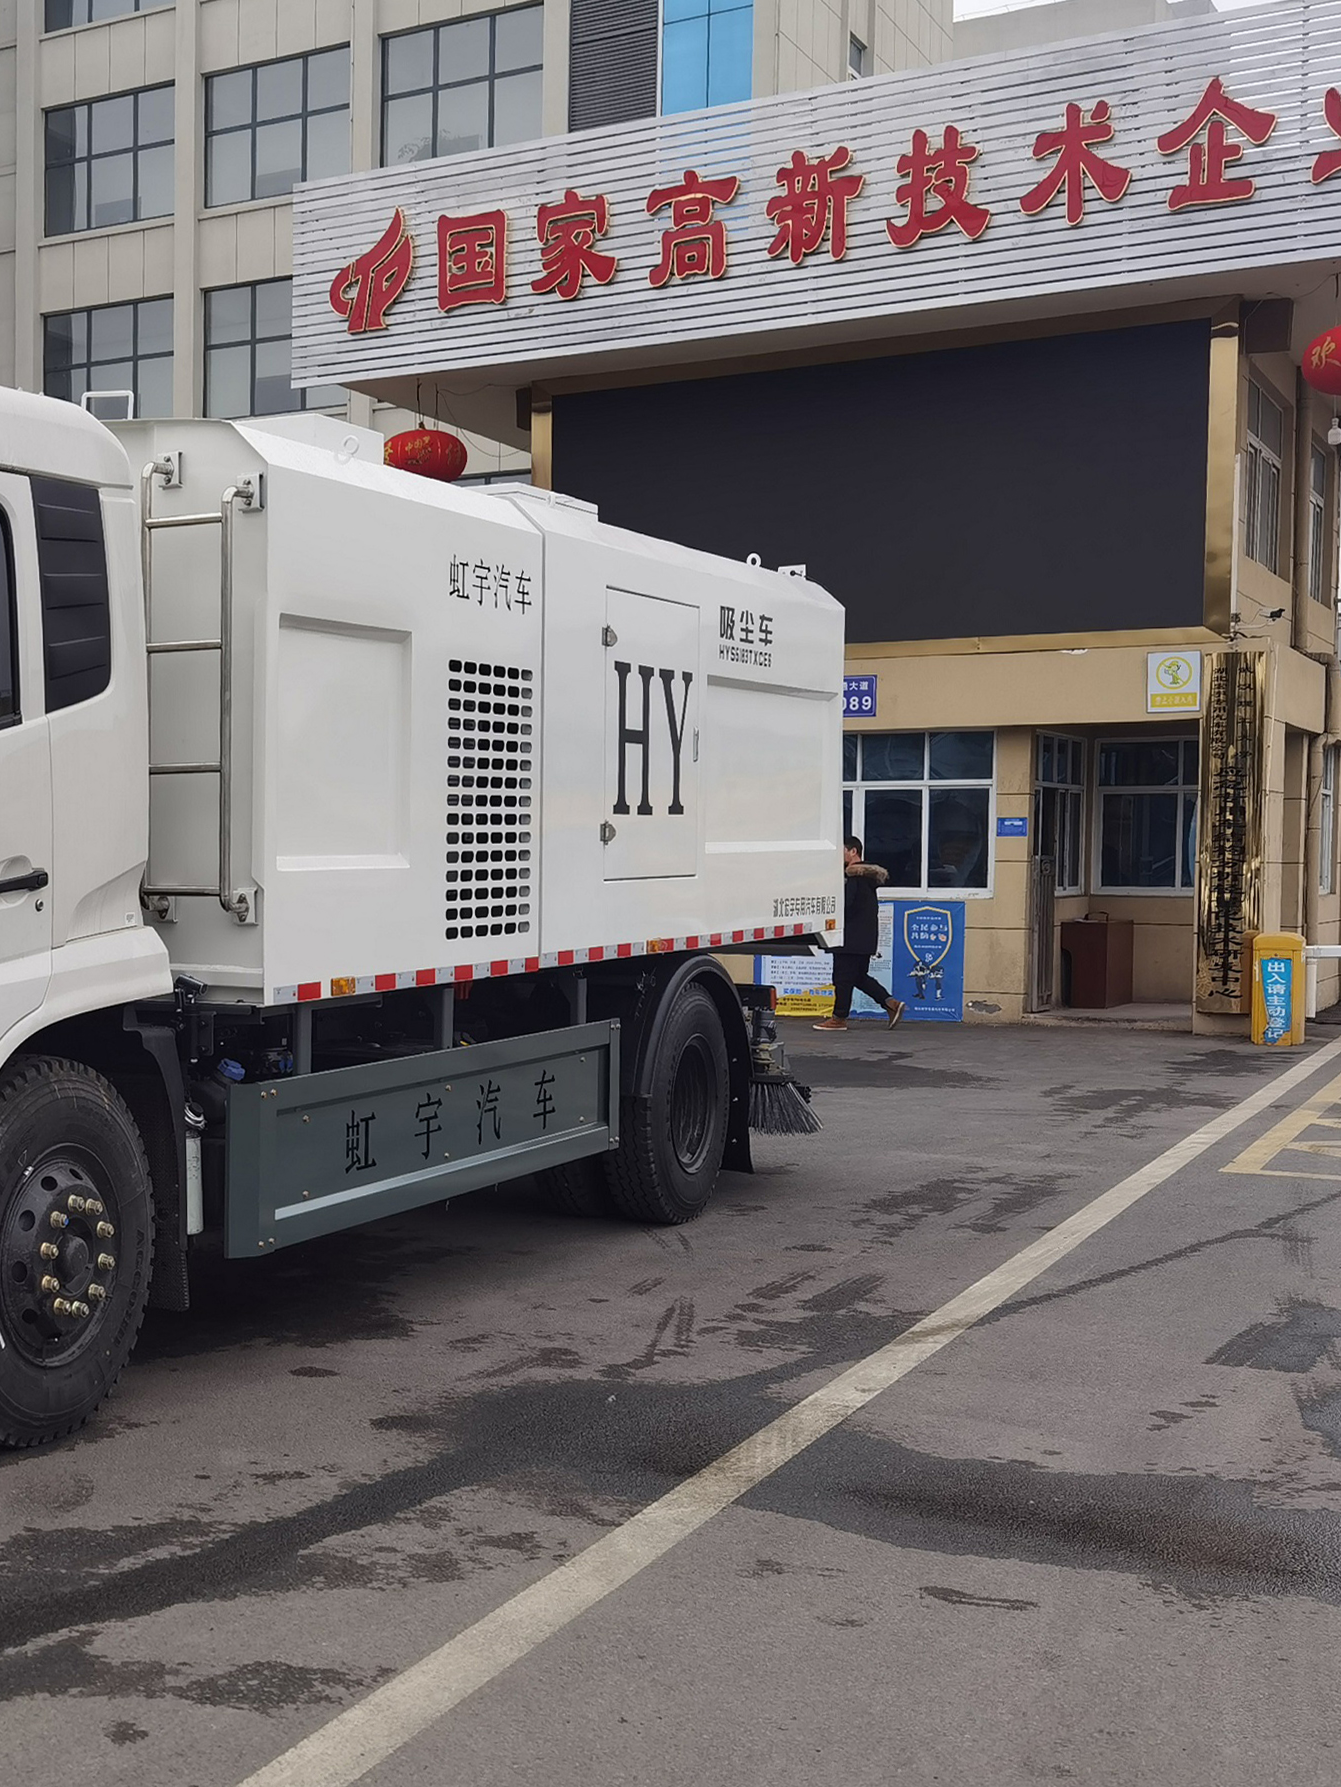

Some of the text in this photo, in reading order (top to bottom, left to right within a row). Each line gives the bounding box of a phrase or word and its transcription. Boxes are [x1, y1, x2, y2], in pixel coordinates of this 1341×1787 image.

[448, 555, 532, 615] 虹宇汽车
[720, 605, 773, 647] 吸尘车
[613, 661, 693, 815] HY
[1266, 962, 1286, 1039] 出入请主动登记
[345, 1068, 556, 1176] 虹宇汽车
